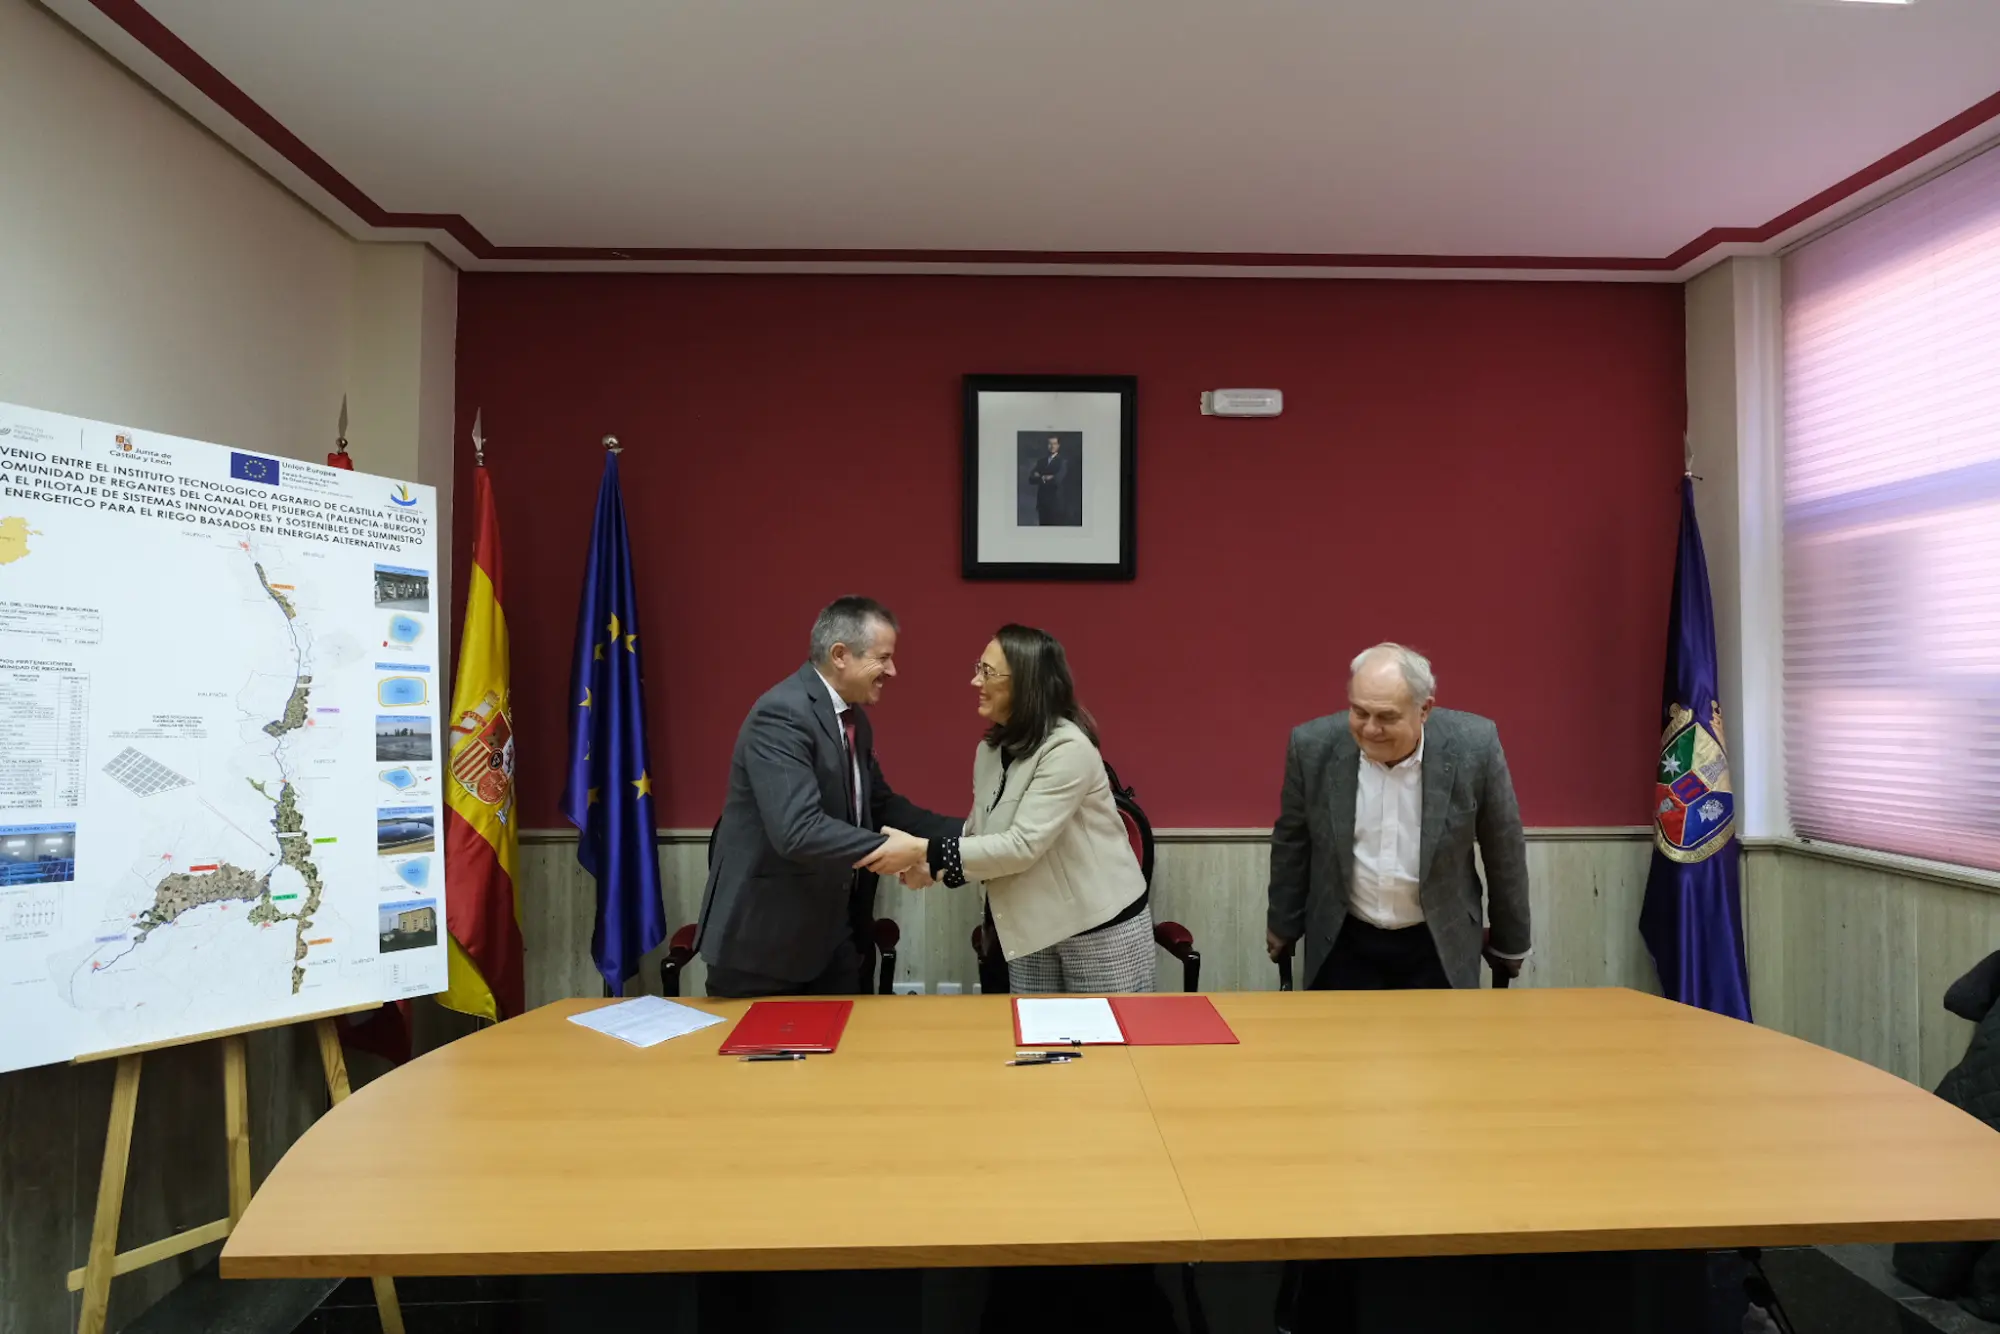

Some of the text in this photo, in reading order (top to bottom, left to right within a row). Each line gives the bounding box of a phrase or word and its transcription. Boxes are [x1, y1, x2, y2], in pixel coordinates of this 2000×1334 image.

[0, 446, 46, 461] VENIO
[52, 455, 92, 469] ENTRE
[97, 463, 110, 473] EL
[113, 466, 175, 483] INSTITUTO
[178, 477, 268, 499] TECNOLOGICO
[270, 493, 321, 508] AGRARIO
[324, 501, 337, 511] DE
[339, 504, 384, 519] CASTILLA
[387, 512, 394, 520] Y
[395, 513, 420, 524] LEON
[422, 518, 428, 526] Y
[109, 449, 142, 460] Castilla
[135, 448, 159, 457] Junta
[1, 460, 426, 537] OMUNIDAD DE REGANTES DEL CANAL DEL PISUERGA (PALENCIA-BURGOS)
[5, 487, 401, 552] ENERGETICO PARA EL RIEGO BASADOS EN ENERGIAS ALTERNATIVAS
[15, 475, 30, 486] EL
[34, 478, 98, 496] PILOTAJE
[102, 488, 119, 499] DE
[123, 491, 181, 509] SISTEMAS
[185, 501, 272, 523] INNOVADORES
[275, 516, 283, 524] Y
[286, 517, 349, 534] SOSTENIBLES
[352, 527, 364, 537] DE
[367, 531, 423, 545] SUMINISTRO
